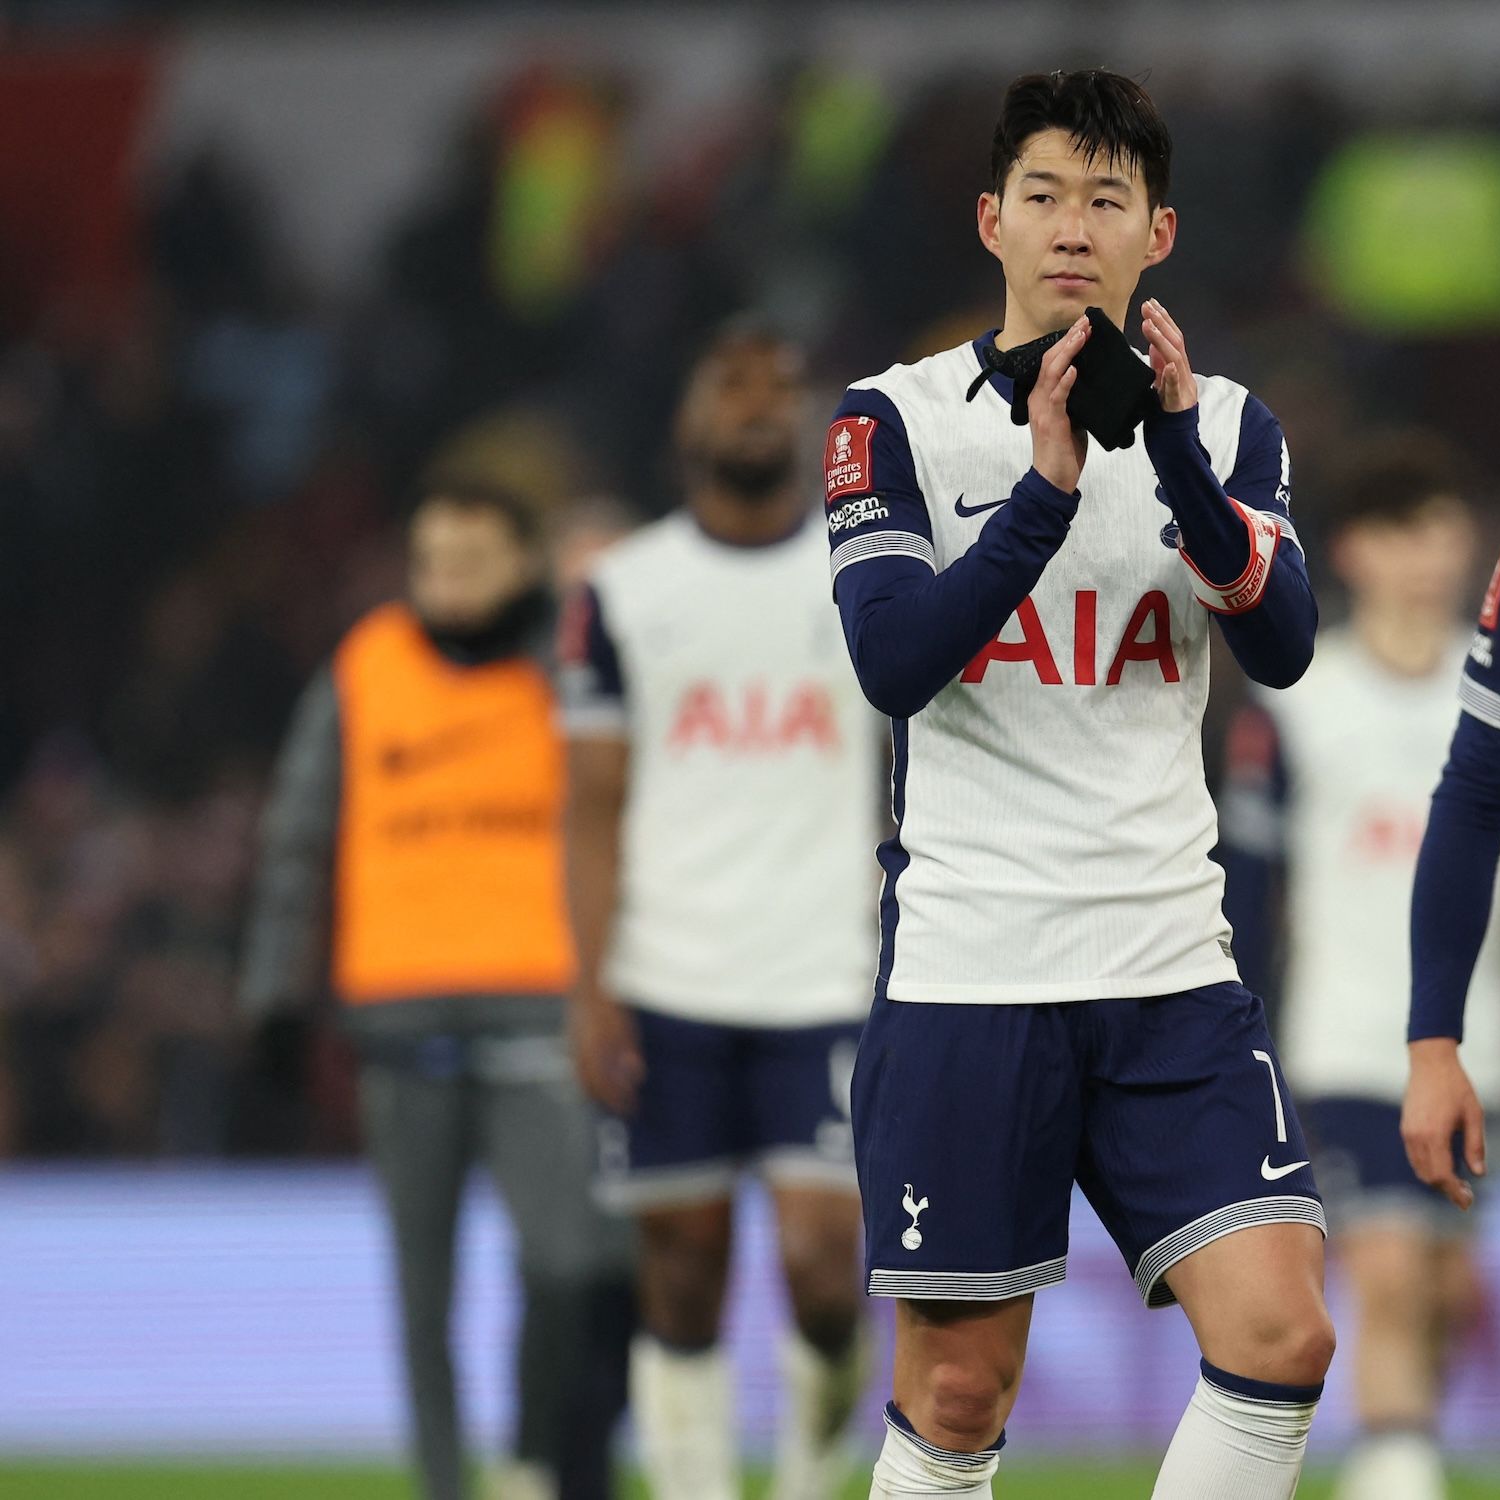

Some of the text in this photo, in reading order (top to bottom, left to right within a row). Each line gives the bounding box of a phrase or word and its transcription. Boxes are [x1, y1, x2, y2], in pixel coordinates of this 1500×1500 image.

[828, 462, 861, 481] Emirates
[837, 471, 862, 486] CUP
[960, 589, 1181, 686] AIA
[664, 676, 844, 763] AIA
[1251, 1049, 1288, 1143] 7
